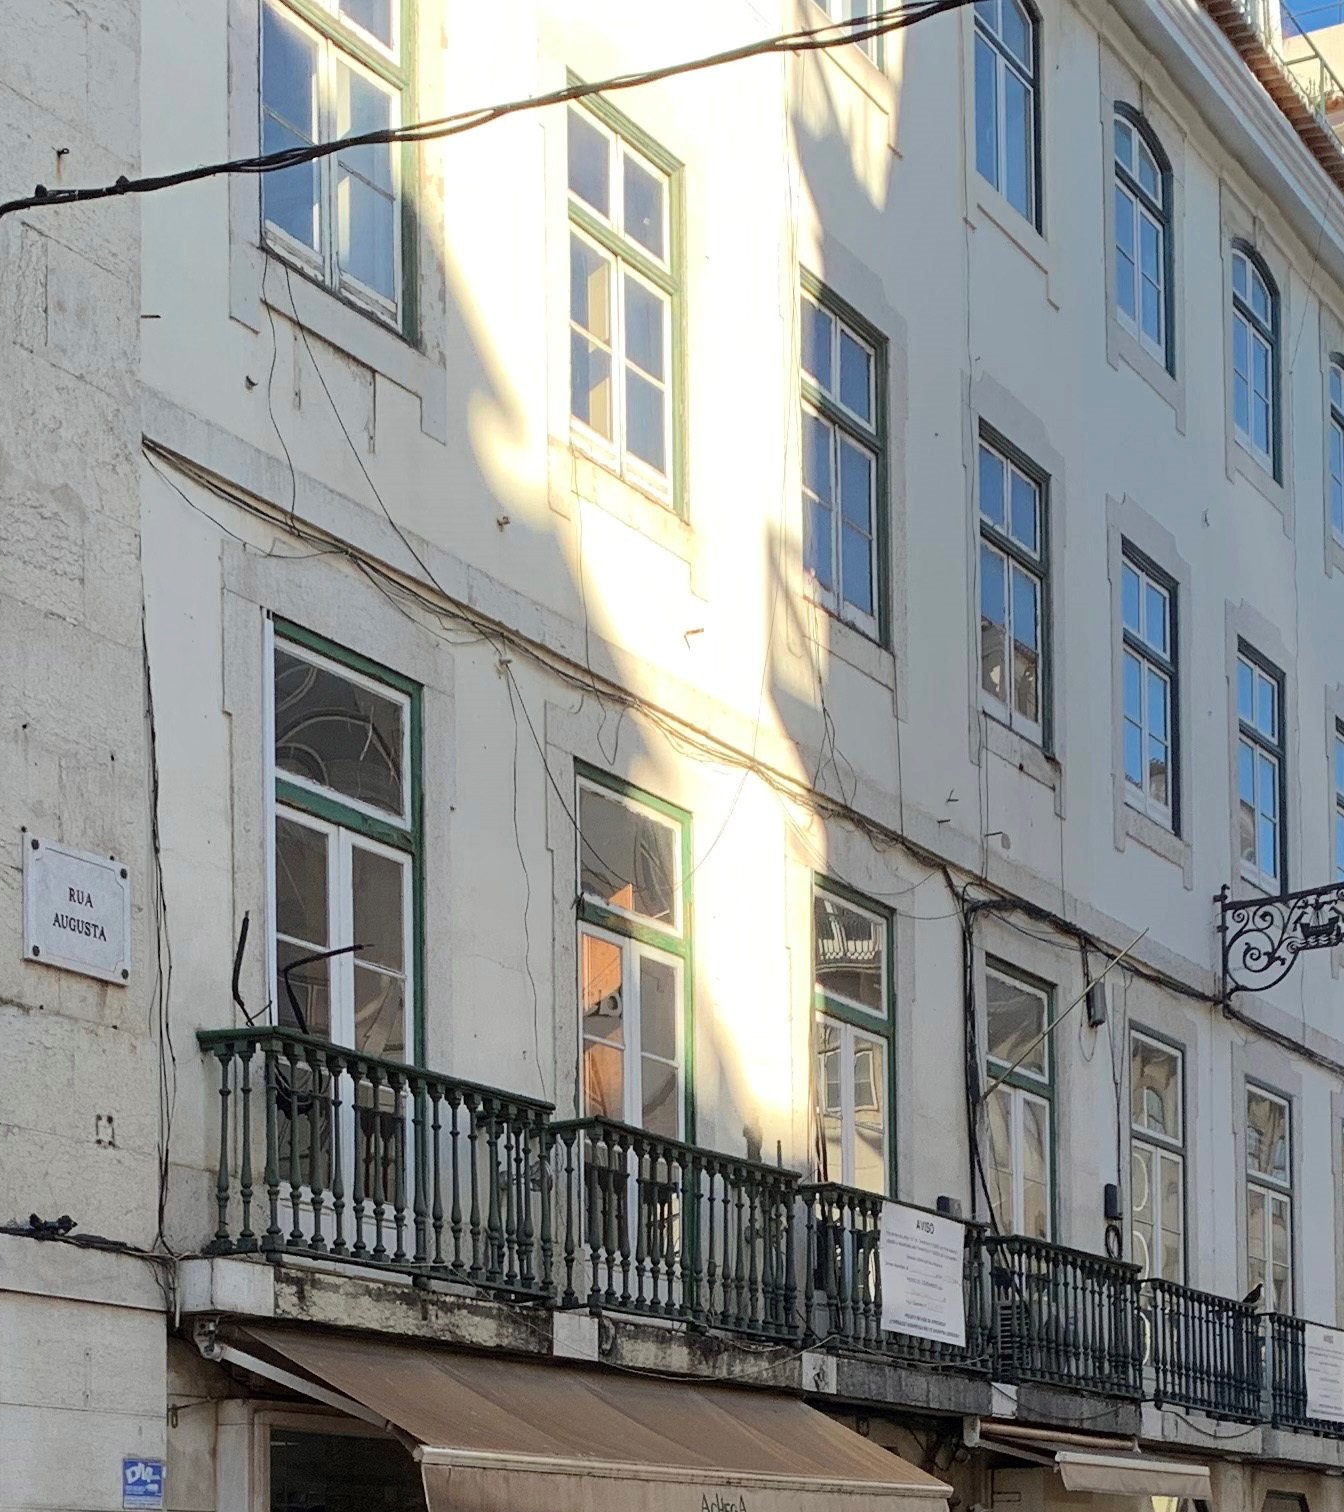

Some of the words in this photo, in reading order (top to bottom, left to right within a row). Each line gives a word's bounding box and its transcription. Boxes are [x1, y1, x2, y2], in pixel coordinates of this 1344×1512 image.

[68, 886, 93, 908] RUA
[52, 912, 107, 942] AUGUSTA
[915, 1218, 935, 1235] AVISO
